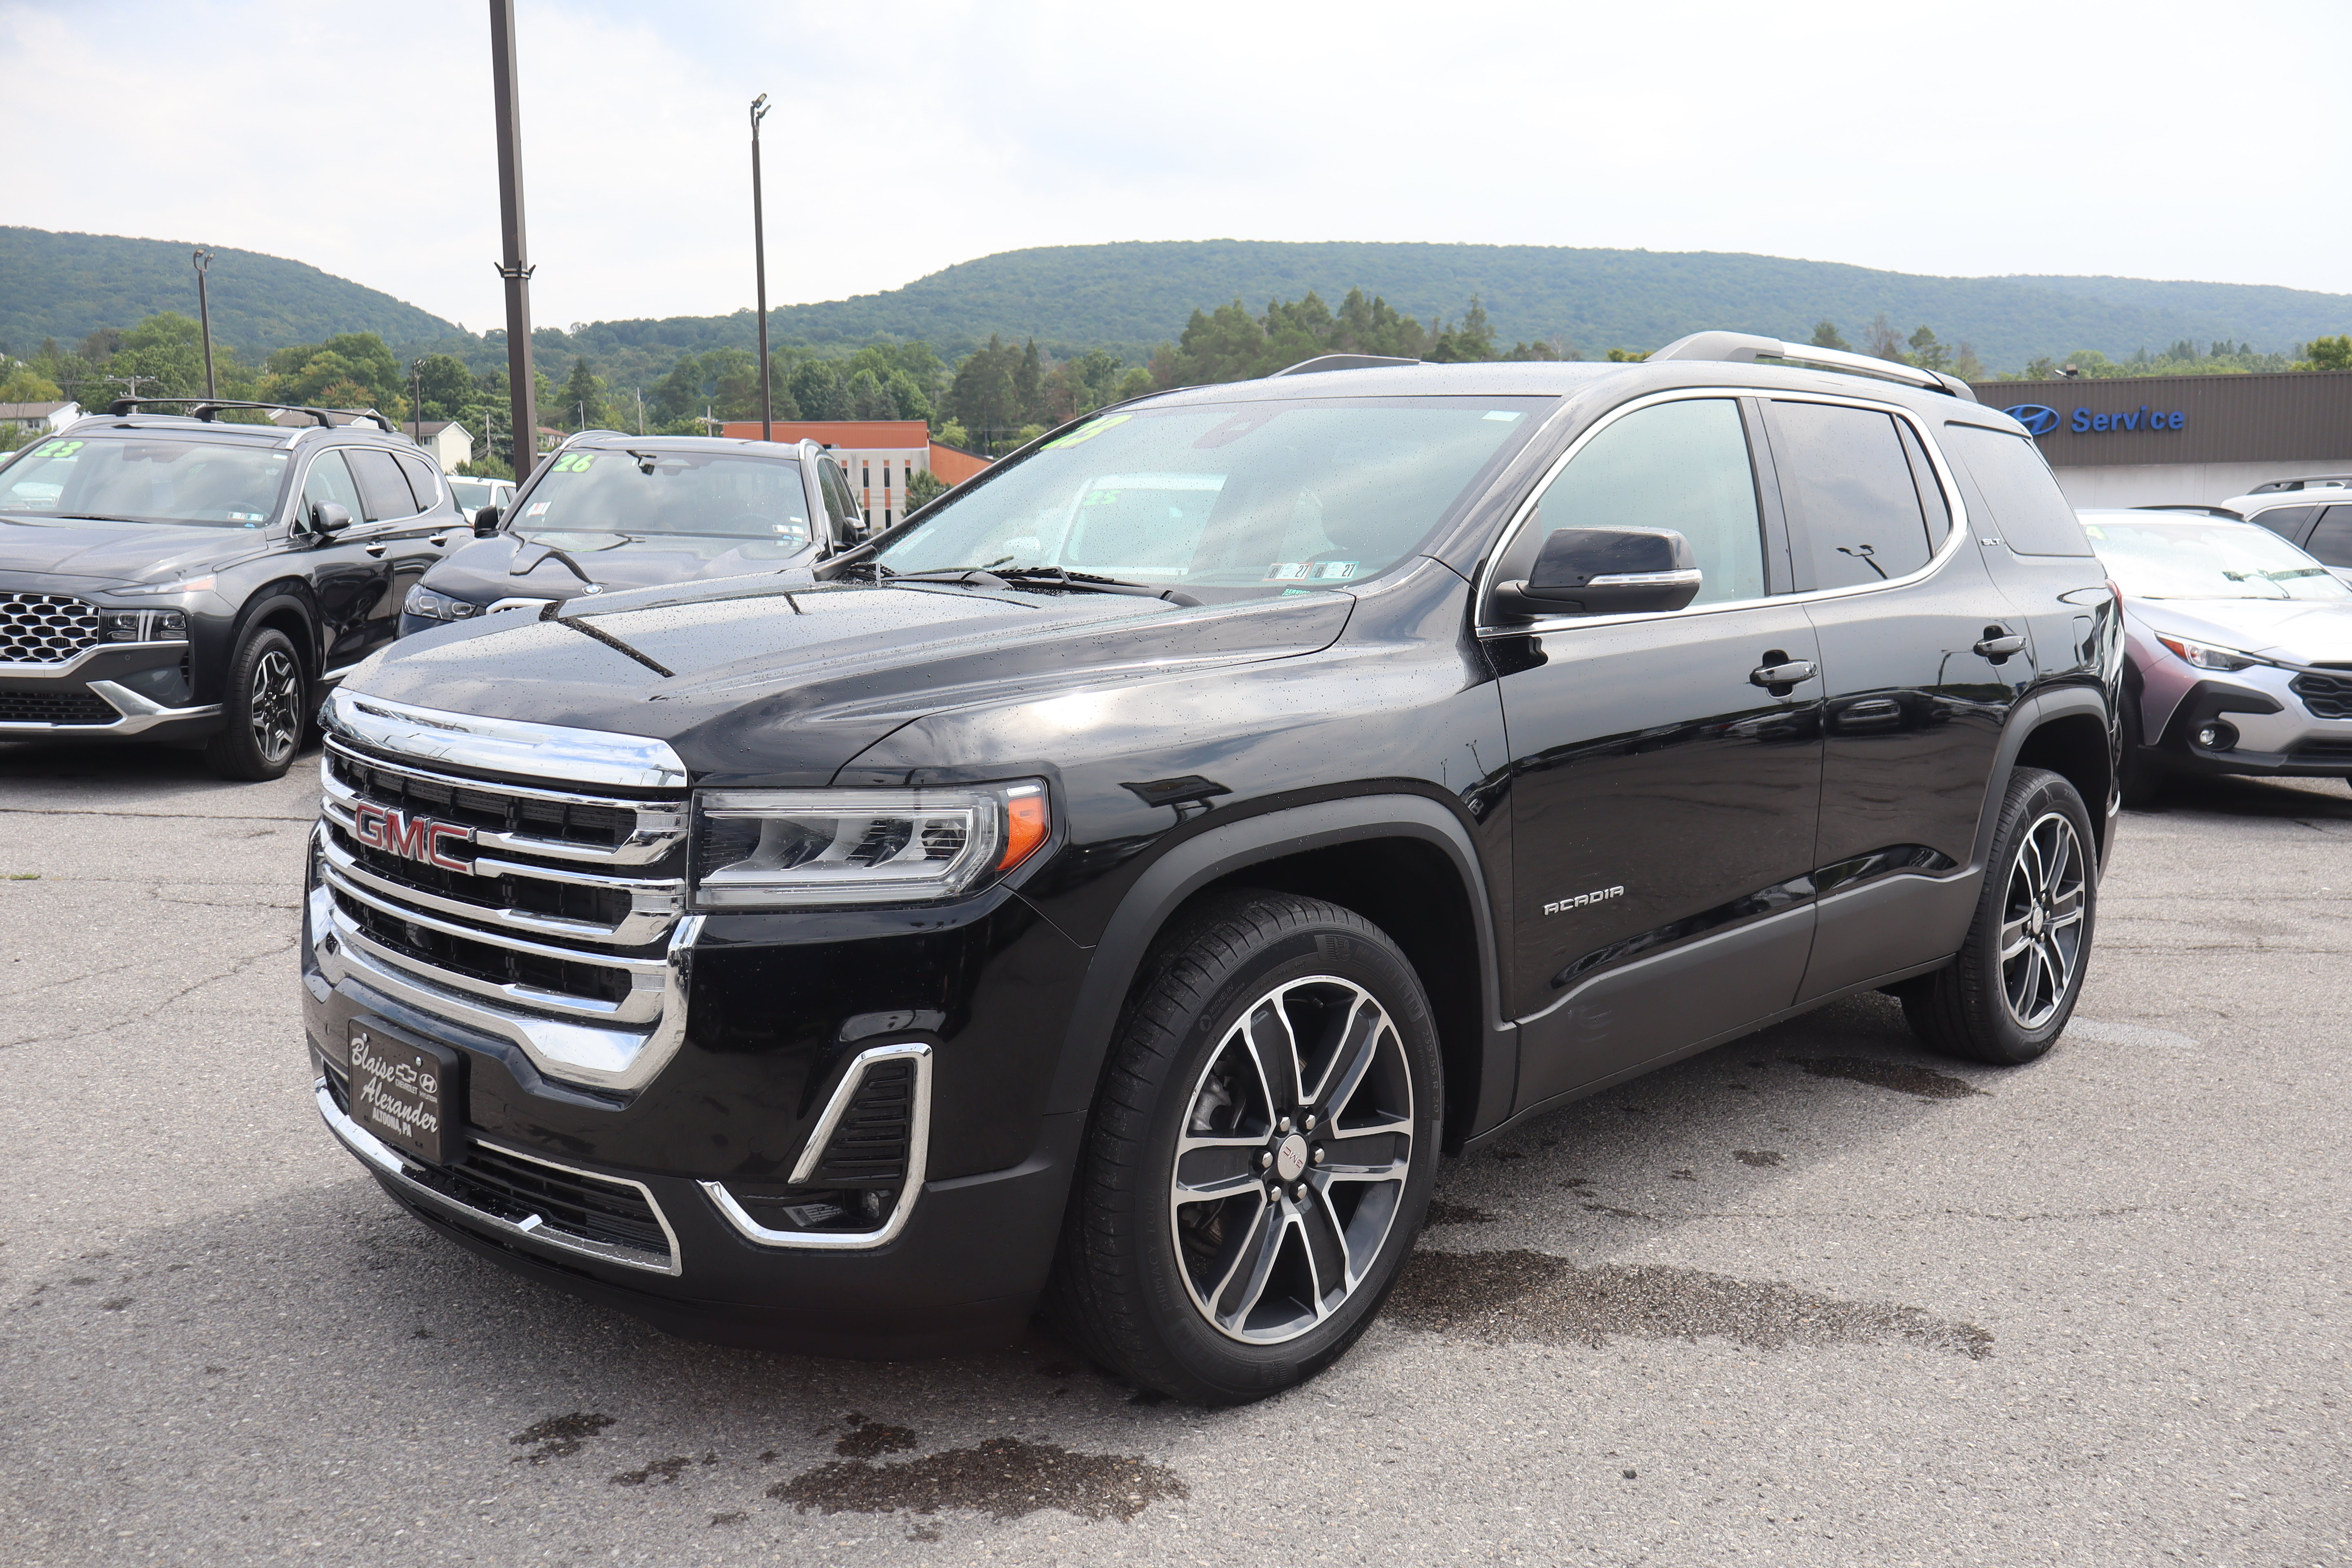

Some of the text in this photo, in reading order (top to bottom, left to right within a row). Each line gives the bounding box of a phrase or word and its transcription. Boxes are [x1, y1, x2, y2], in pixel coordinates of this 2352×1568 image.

[2071, 405, 2185, 432] Service
[34, 441, 84, 457] 23
[552, 454, 595, 472] 26
[1268, 565, 1309, 579] 8 27
[1314, 564, 1355, 578] 8 27
[355, 798, 477, 876] GMC
[1542, 885, 1624, 915] ACADIA
[1209, 983, 1234, 1015] MICHELIN
[351, 1038, 395, 1082] Blaise
[1422, 1029, 1438, 1076] 235/55
[395, 1078, 418, 1095] CHEVROLET
[1432, 1080, 1439, 1089] R
[360, 1076, 438, 1133] Alexander
[419, 1091, 438, 1104] HYUNDAI
[1433, 1096, 1440, 1113] 20
[372, 1107, 412, 1138] ALTOONA, PA
[1283, 1145, 1304, 1169] GMC
[1148, 1245, 1171, 1312] PRIMACY
